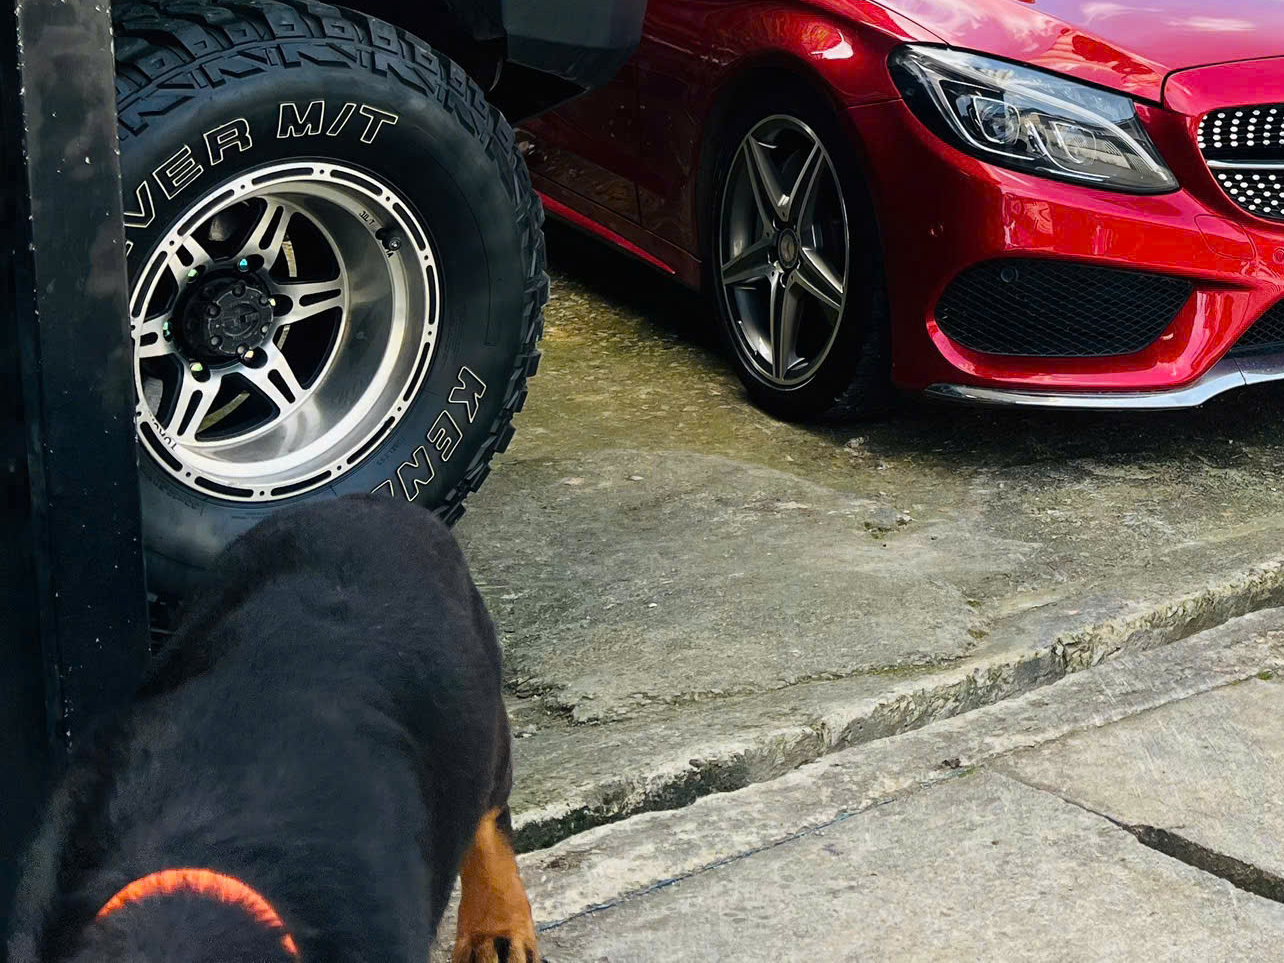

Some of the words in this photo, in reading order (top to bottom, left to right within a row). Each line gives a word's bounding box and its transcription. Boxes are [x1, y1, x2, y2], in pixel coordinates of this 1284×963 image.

[124, 118, 253, 256] VER
[277, 100, 399, 144] M/T
[370, 365, 487, 502] KEN
